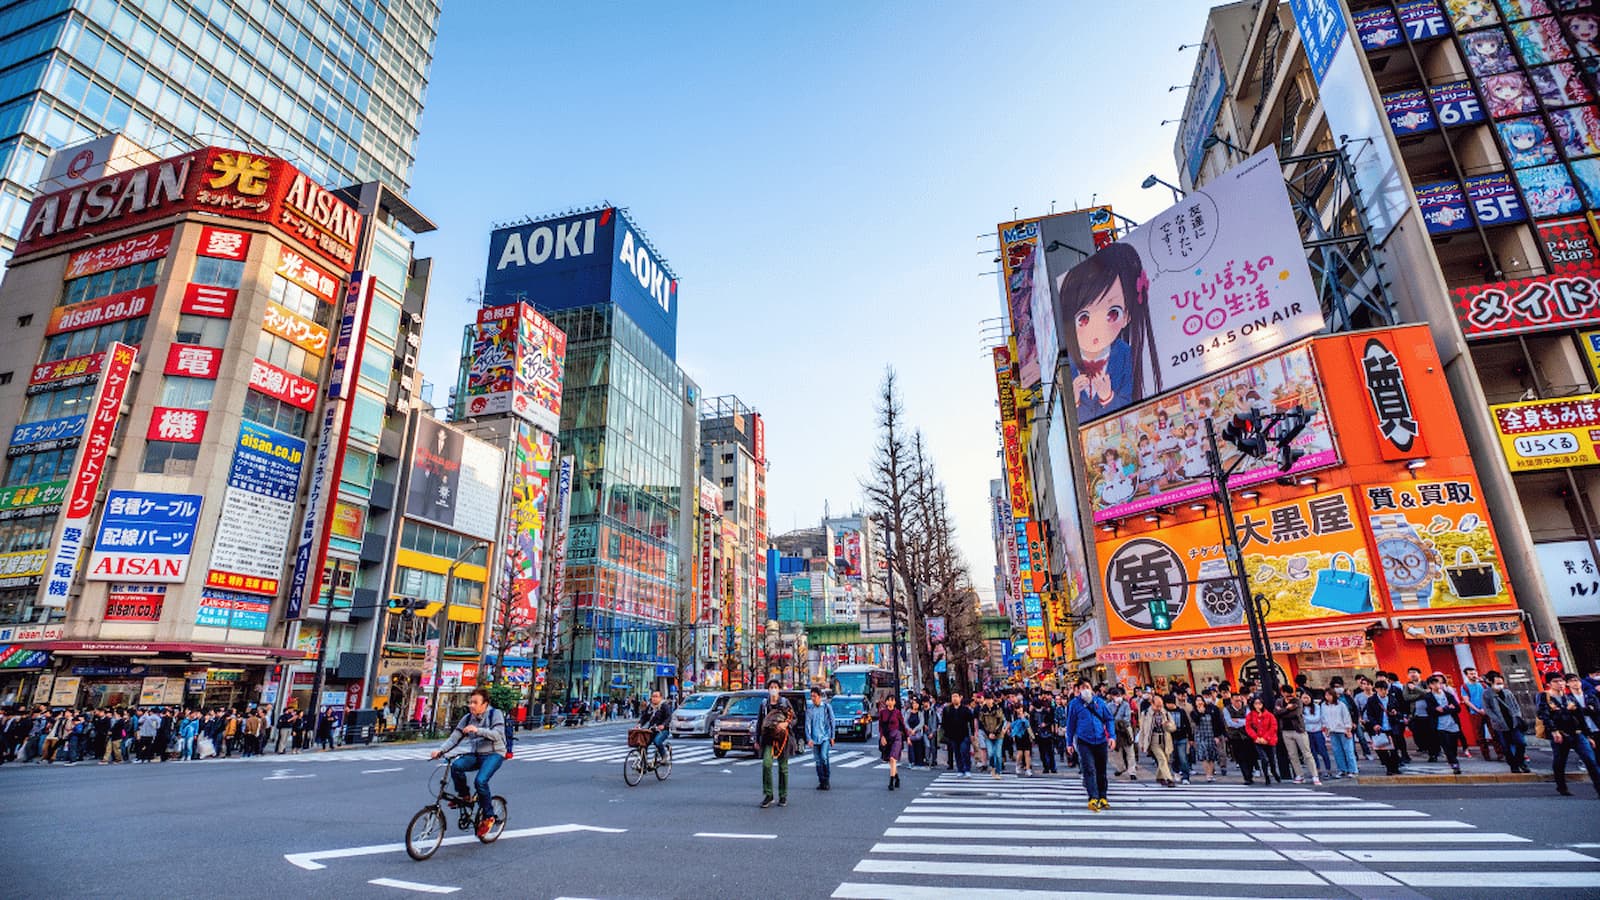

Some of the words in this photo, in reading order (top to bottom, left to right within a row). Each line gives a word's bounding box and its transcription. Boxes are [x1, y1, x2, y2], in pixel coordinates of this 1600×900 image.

[1406, 16, 1445, 40] 7F
[1440, 99, 1480, 124] 6F
[209, 152, 271, 196] 光
[21, 156, 196, 242] AISAN
[197, 189, 271, 213] ネットワーク
[286, 173, 361, 246] AISAN
[1475, 195, 1519, 221] 5F
[1175, 214, 1193, 258] なりたい
[1188, 203, 1207, 240] 友達に
[206, 230, 243, 257] 愛
[496, 218, 597, 271] AOKI
[1551, 248, 1594, 263] Stars
[278, 251, 336, 299] 光通信
[619, 230, 671, 314] AOKI
[1170, 255, 1275, 312] ひとりぼっちの
[58, 295, 146, 330] aisan.co.jp
[191, 287, 229, 313] 三
[483, 305, 515, 321] 免税店
[1471, 280, 1600, 327] メイド
[264, 306, 328, 349] ネットワーク
[1170, 330, 1238, 368] 2019.4.5
[1240, 317, 1268, 337] ON
[1270, 302, 1304, 326] AIR
[33, 365, 51, 380] 3F
[176, 346, 214, 376] 電
[1363, 353, 1419, 440] 質
[13, 428, 30, 442] 2F
[31, 416, 87, 440] ネットワーク
[158, 409, 198, 439] 機
[1503, 404, 1600, 430] 全身もみほ
[240, 433, 302, 465] aisan.co.jp
[1519, 436, 1574, 453] りらくる
[109, 496, 196, 517] 各種ケーブル
[1235, 492, 1355, 551] 大黒屋
[47, 526, 82, 597] 愛三電機
[94, 557, 183, 577] AISAN
[285, 547, 308, 612] AISAN
